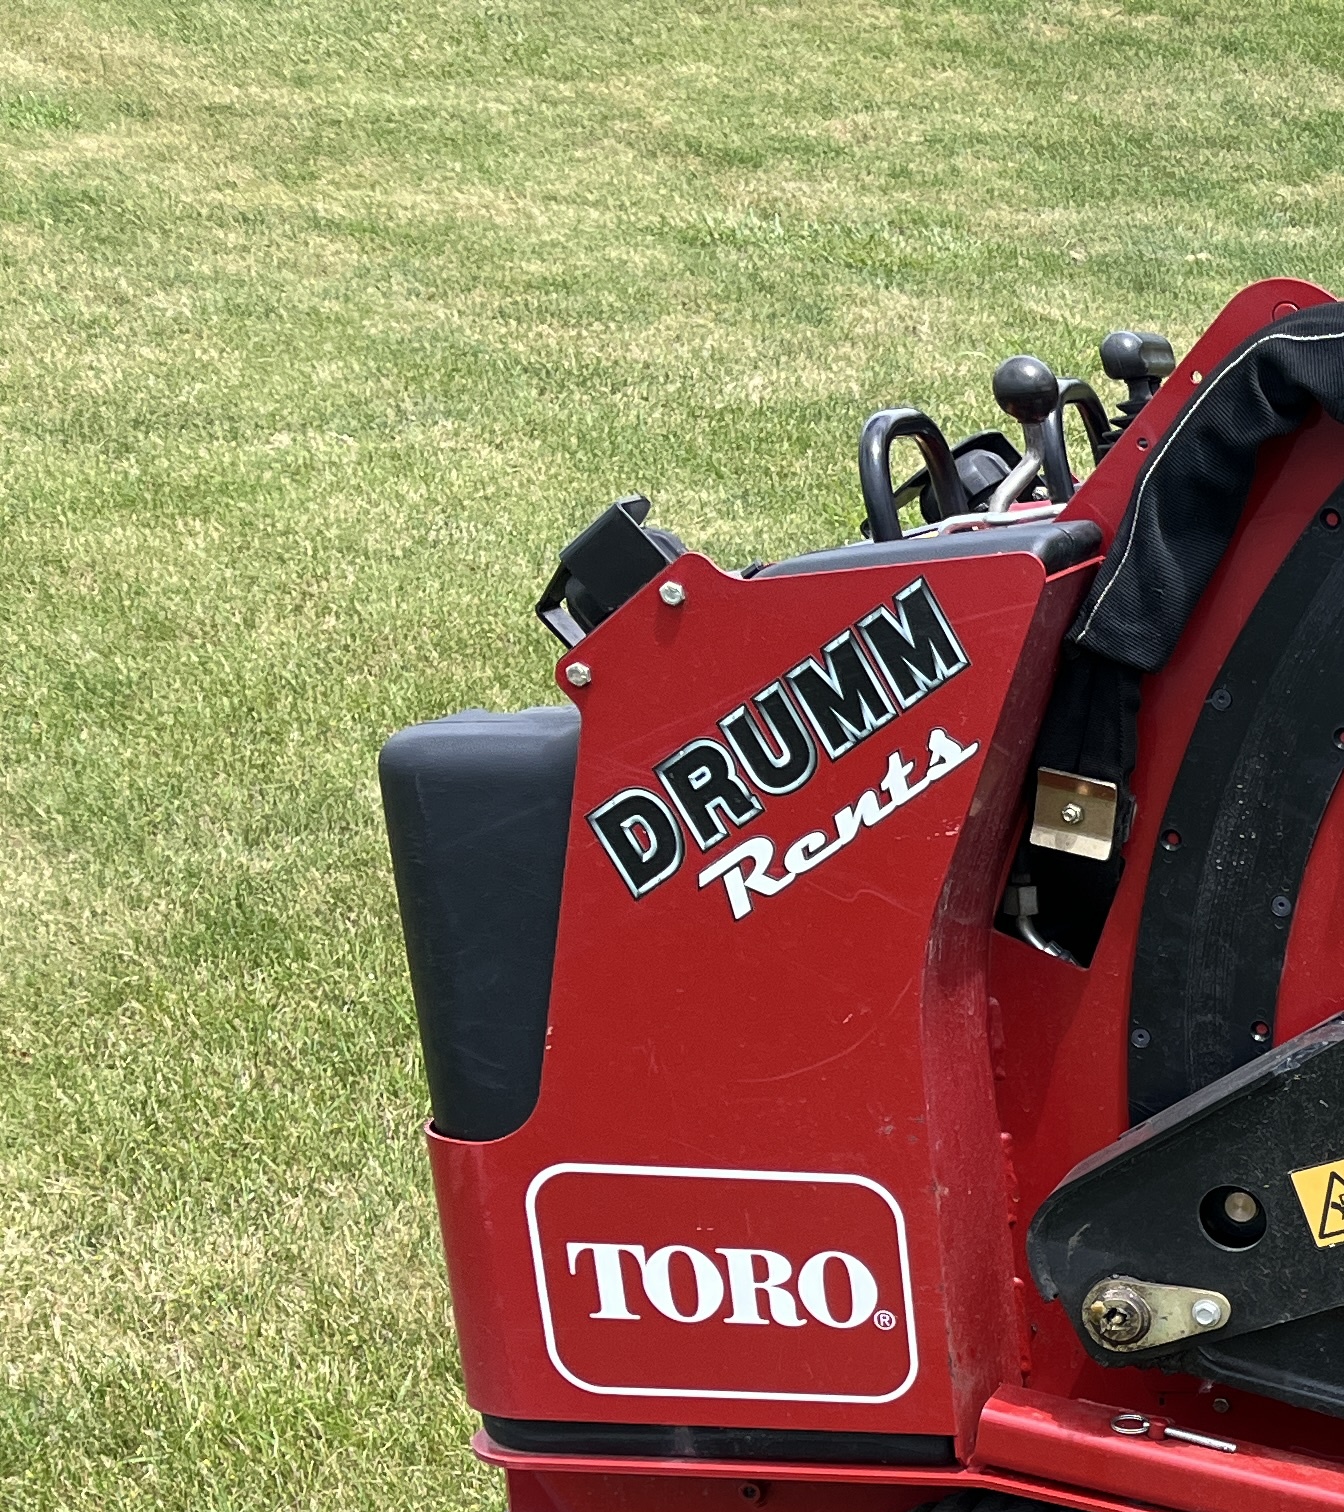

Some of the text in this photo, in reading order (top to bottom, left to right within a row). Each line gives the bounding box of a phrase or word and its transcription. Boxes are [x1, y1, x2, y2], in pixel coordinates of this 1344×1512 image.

[586, 575, 971, 899] DRUMM
[697, 727, 979, 921] Rents
[566, 1241, 878, 1329] TORO
